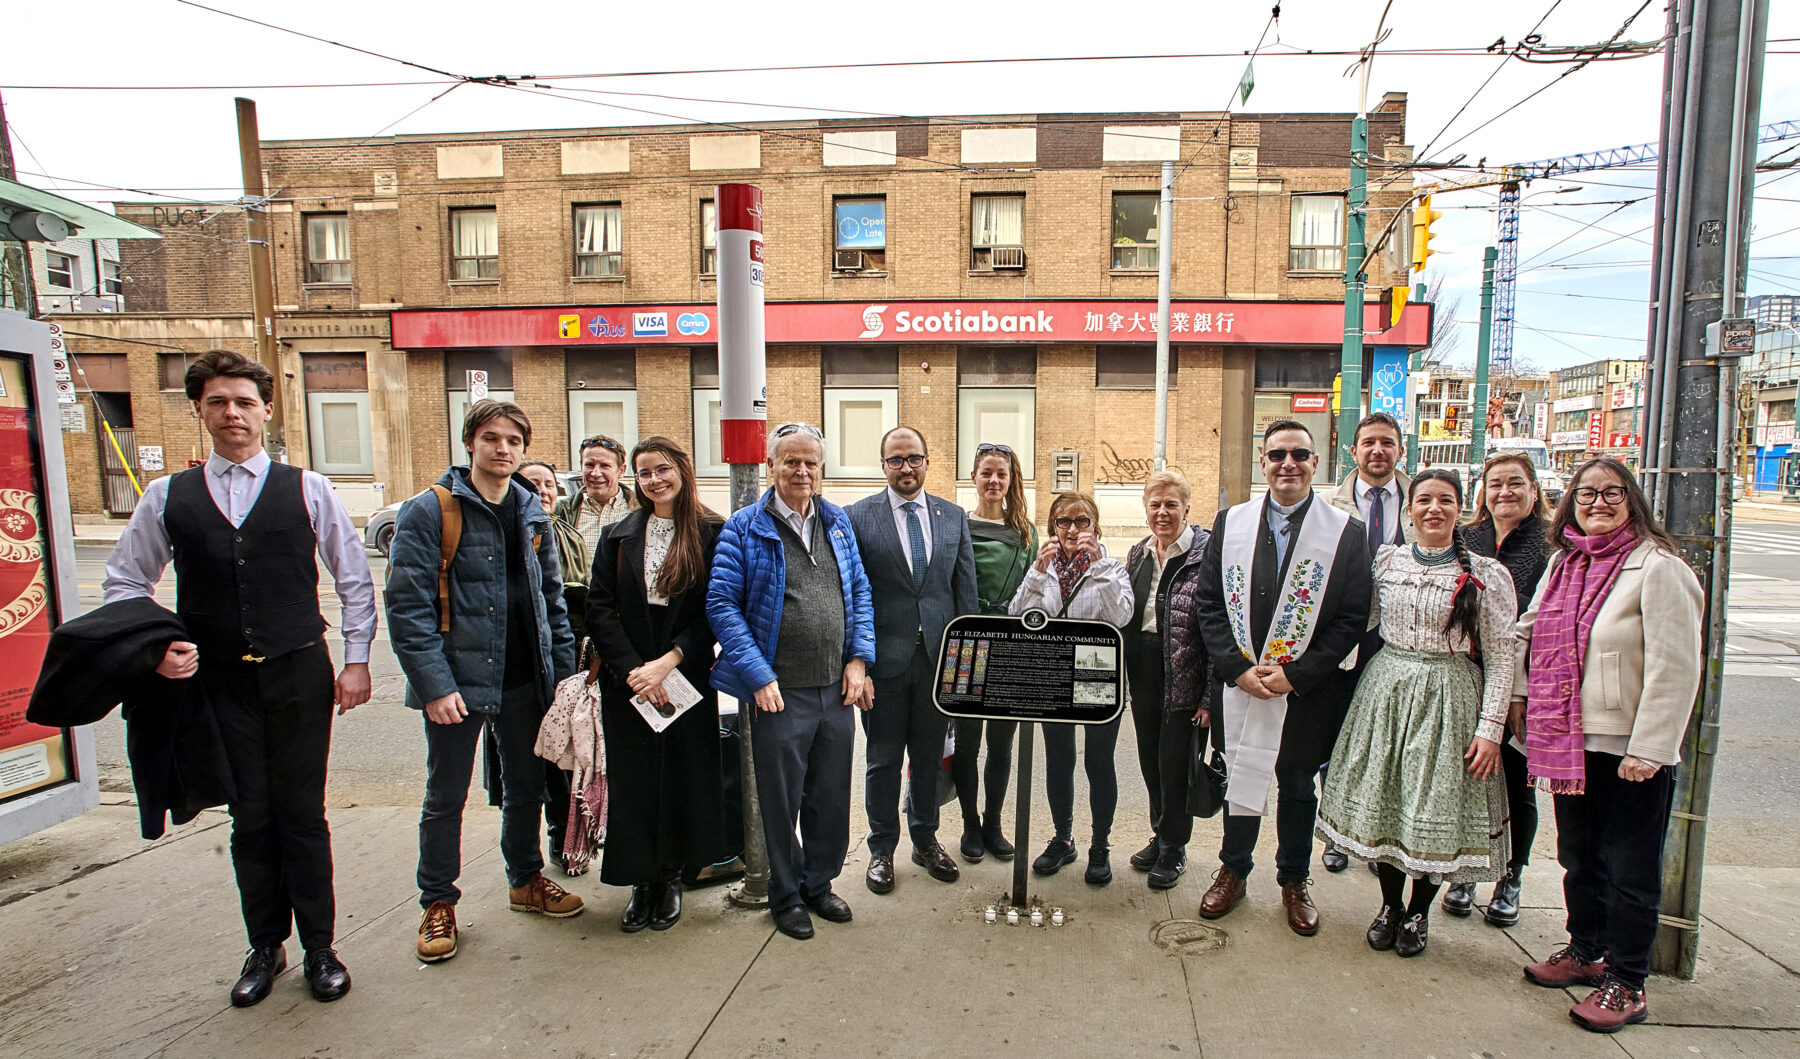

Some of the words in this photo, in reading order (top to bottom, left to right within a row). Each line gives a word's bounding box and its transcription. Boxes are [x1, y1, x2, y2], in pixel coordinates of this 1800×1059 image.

[861, 216, 886, 228] Open
[865, 228, 883, 238] Late
[638, 316, 665, 328] VISA
[895, 309, 1054, 333] Scotiabank
[597, 324, 625, 338] PLUS
[950, 630, 962, 638] ST.
[964, 631, 1008, 639] ELIZABETH
[1011, 632, 1063, 642] HUNGARIAN
[1064, 635, 1116, 645] COMMUNITY
